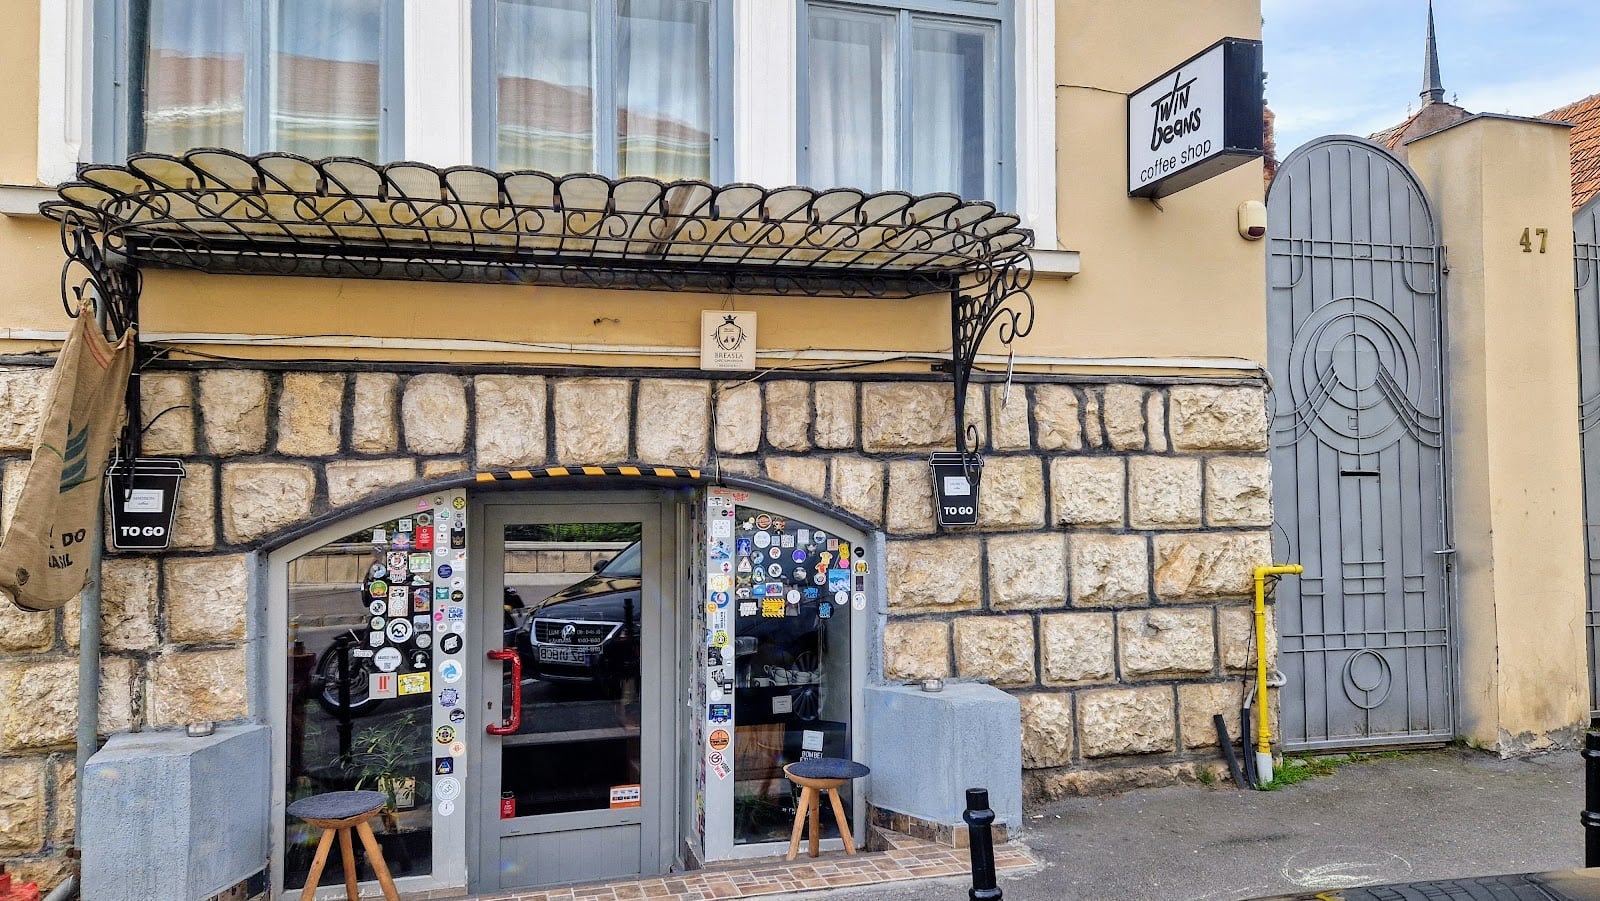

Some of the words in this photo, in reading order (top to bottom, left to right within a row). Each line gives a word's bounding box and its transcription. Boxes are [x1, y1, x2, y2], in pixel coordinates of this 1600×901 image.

[1141, 156, 1176, 182] coffee
[1181, 140, 1211, 164] shop
[1519, 227, 1548, 253] 47
[944, 506, 957, 515] TO
[958, 506, 973, 515] GO
[62, 528, 86, 547] DO
[121, 526, 140, 537] TO
[142, 526, 164, 537] GO
